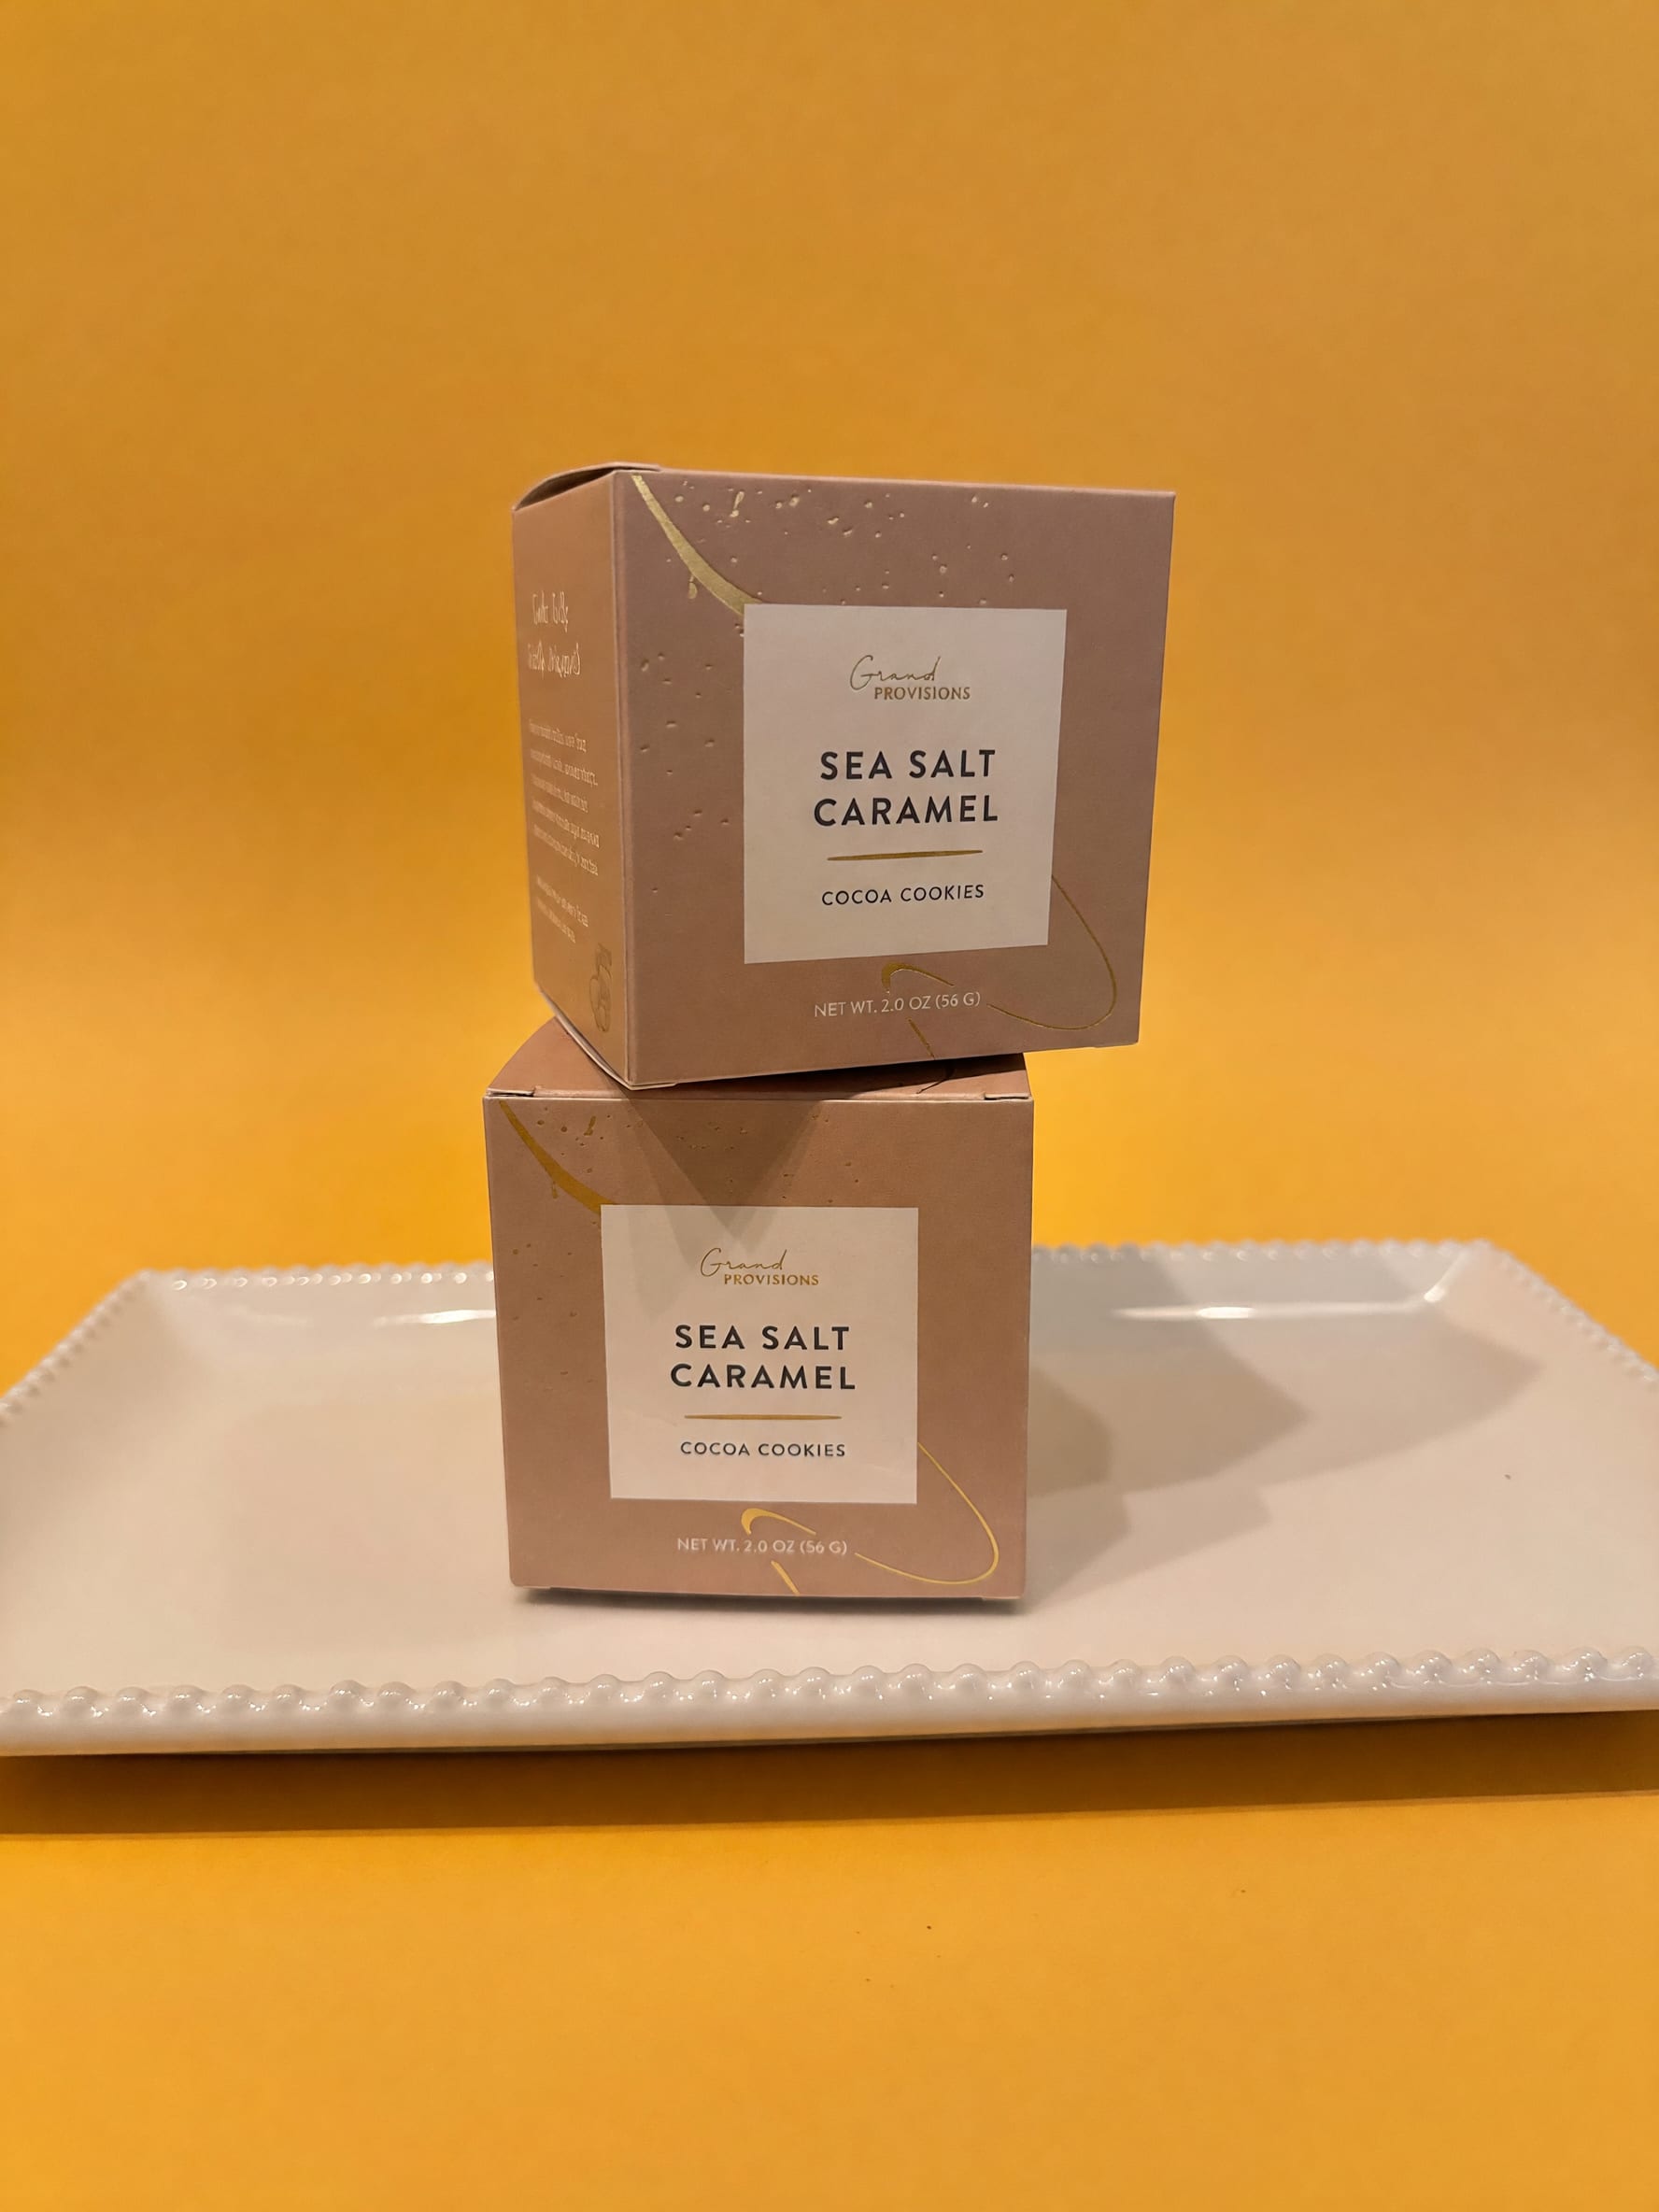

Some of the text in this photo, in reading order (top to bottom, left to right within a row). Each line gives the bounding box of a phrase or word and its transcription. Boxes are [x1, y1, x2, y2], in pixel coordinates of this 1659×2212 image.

[849, 655, 941, 690] Grand
[873, 687, 971, 701] PROVISIONS
[820, 749, 996, 780] SEA SALT
[814, 795, 998, 827] CARAMEL
[821, 885, 985, 906] COCOA COOKIES
[815, 991, 981, 1017] NET WT. 2.0 OZ (56 G)
[700, 1248, 787, 1277] Grand
[724, 1274, 819, 1286] PROVISIONS
[675, 1325, 849, 1351] SEA SALT
[671, 1364, 856, 1390] CARAMEL
[680, 1441, 845, 1457] COCOA COOKIES
[677, 1538, 847, 1555] NET WT. 2.0 OZ (56 G)
